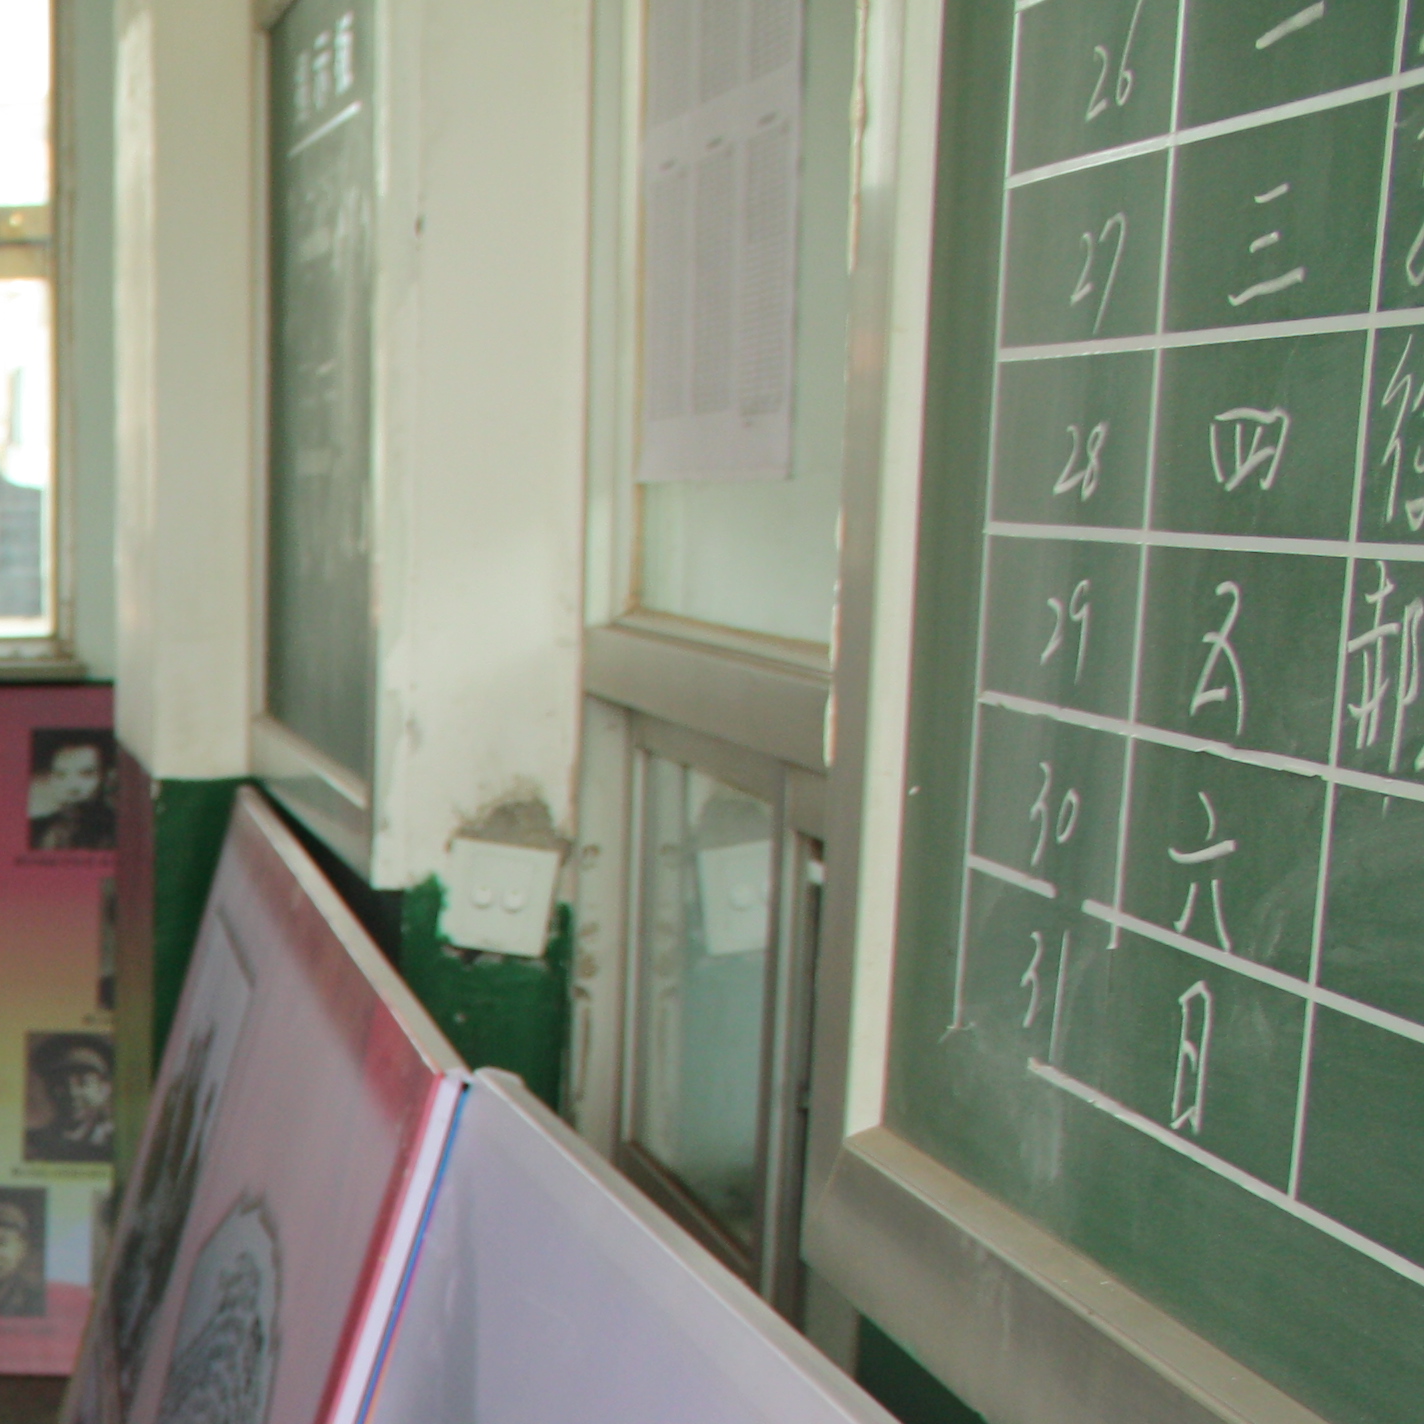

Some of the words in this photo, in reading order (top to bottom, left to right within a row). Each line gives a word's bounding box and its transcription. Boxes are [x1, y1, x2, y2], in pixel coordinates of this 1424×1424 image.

[1085, 0, 1144, 122] 26
[1070, 211, 1127, 335] 27
[1229, 183, 1305, 306] 三
[1053, 421, 1109, 500] 28
[1209, 405, 1291, 491] 四
[1040, 577, 1091, 686] 29
[1190, 580, 1244, 736] 五
[1030, 762, 1080, 867] 30
[1168, 791, 1237, 953] 六
[1020, 930, 1070, 1062] 31
[1170, 980, 1213, 1134] 日
